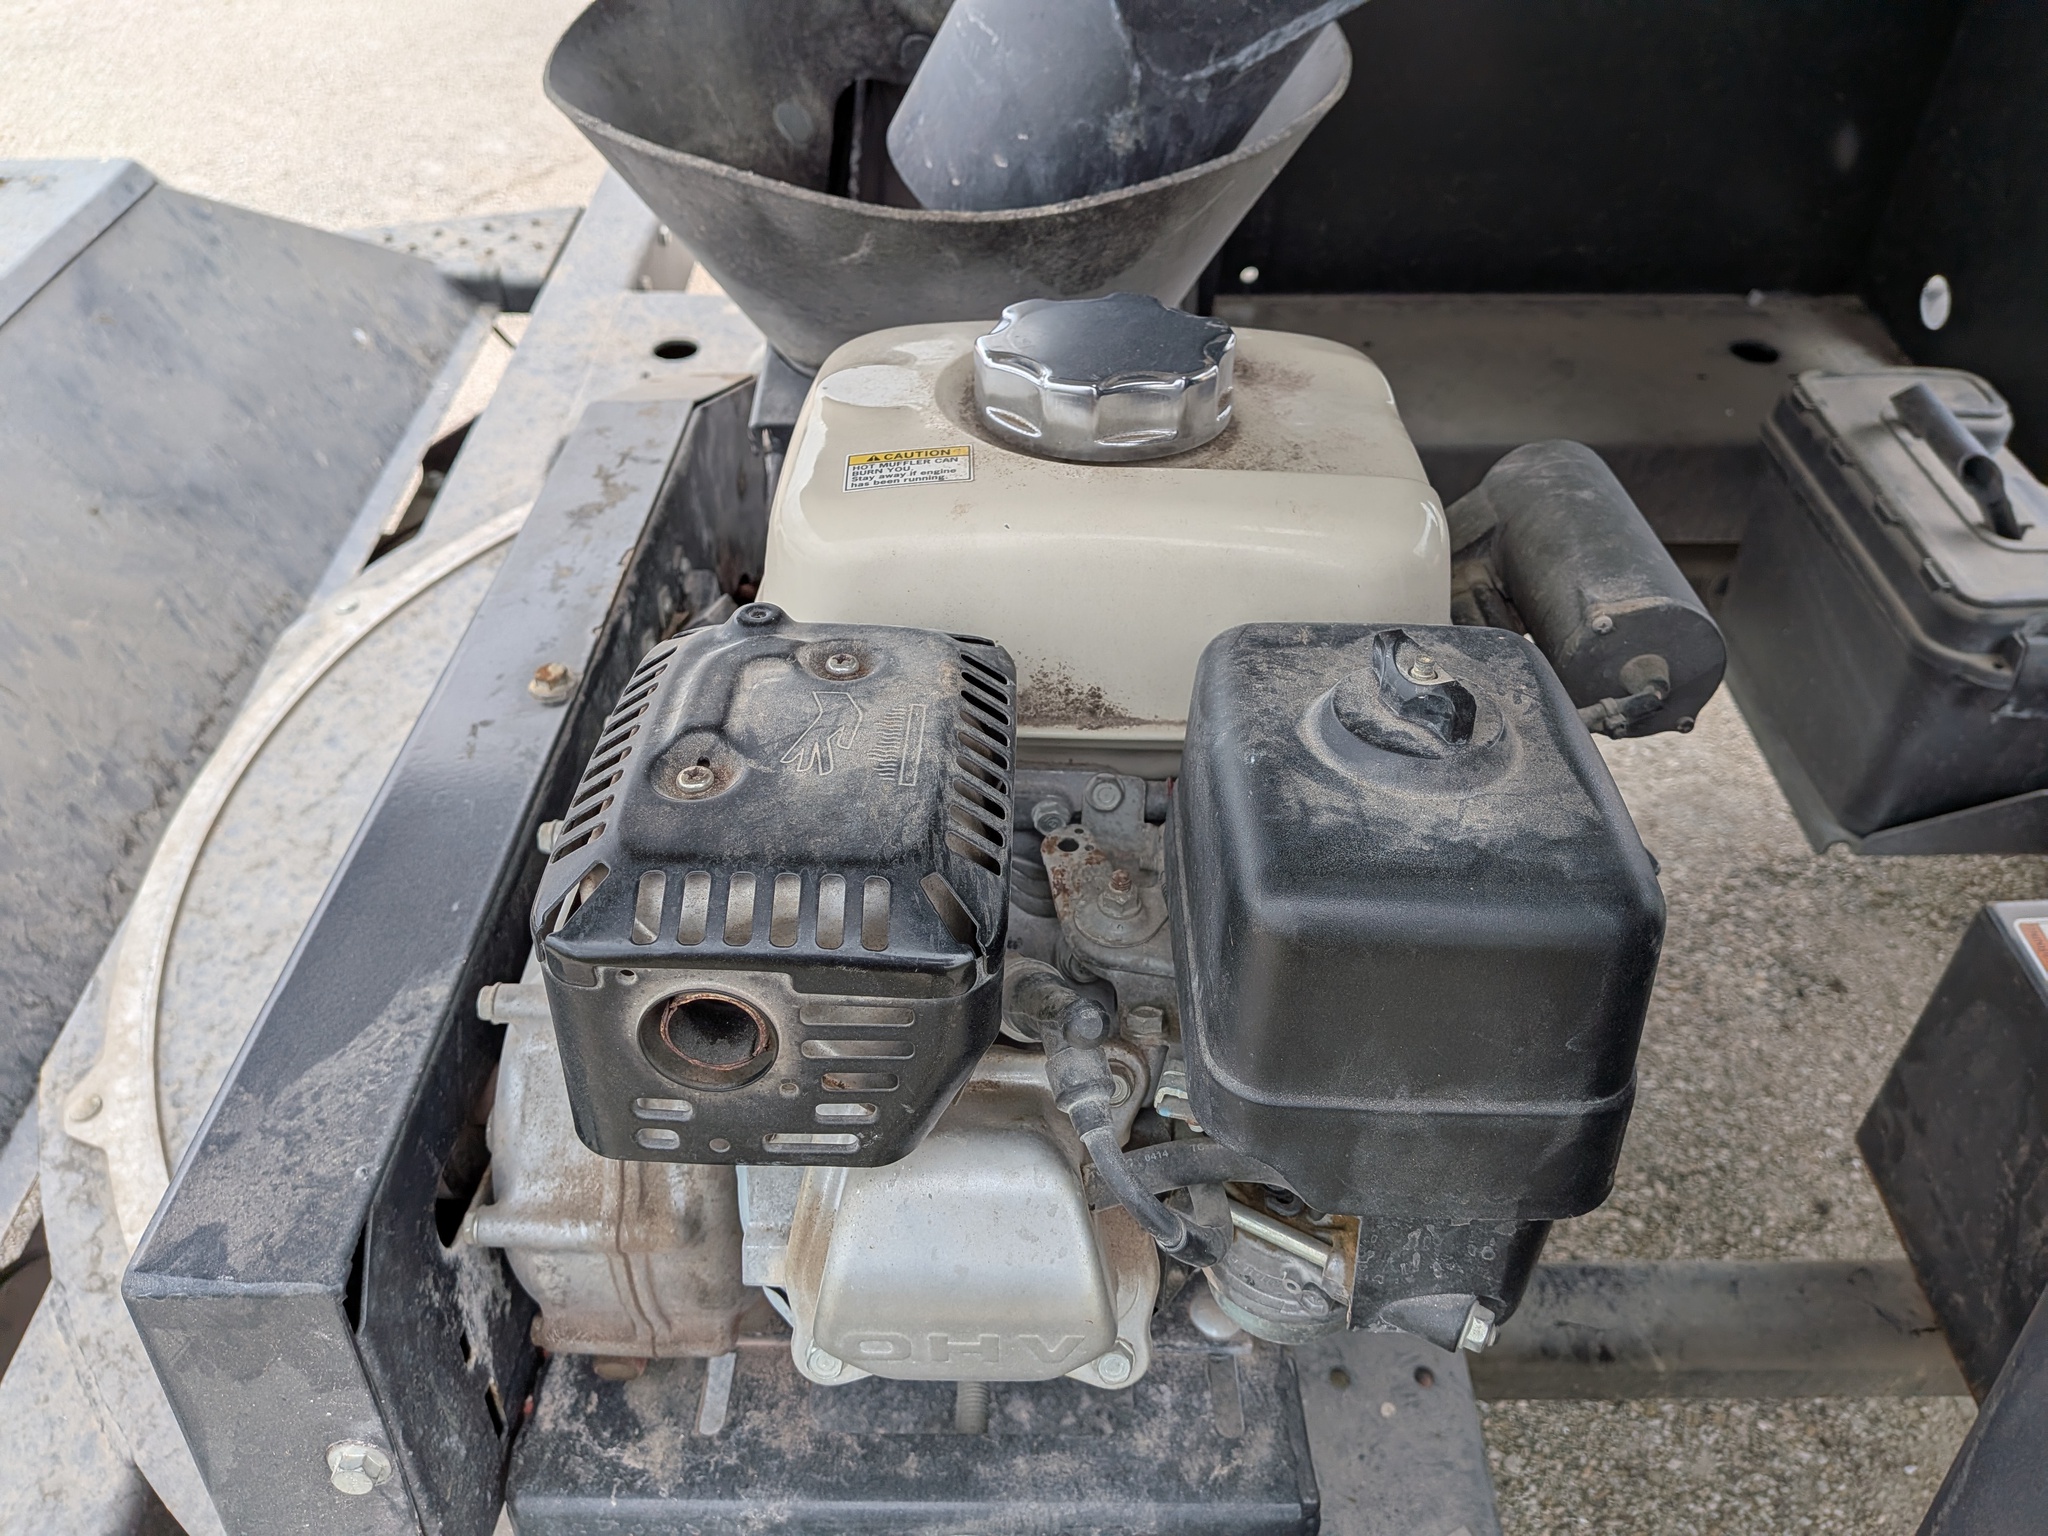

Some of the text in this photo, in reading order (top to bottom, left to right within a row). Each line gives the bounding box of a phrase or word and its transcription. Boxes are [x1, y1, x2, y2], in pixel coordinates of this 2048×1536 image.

[884, 449, 951, 461] CAUTION
[879, 459, 931, 468] MUFFLER
[852, 468, 883, 477] BURN
[910, 468, 917, 476] if
[920, 468, 957, 476] engine
[873, 478, 900, 486] been
[843, 1332, 1086, 1363] OHV
